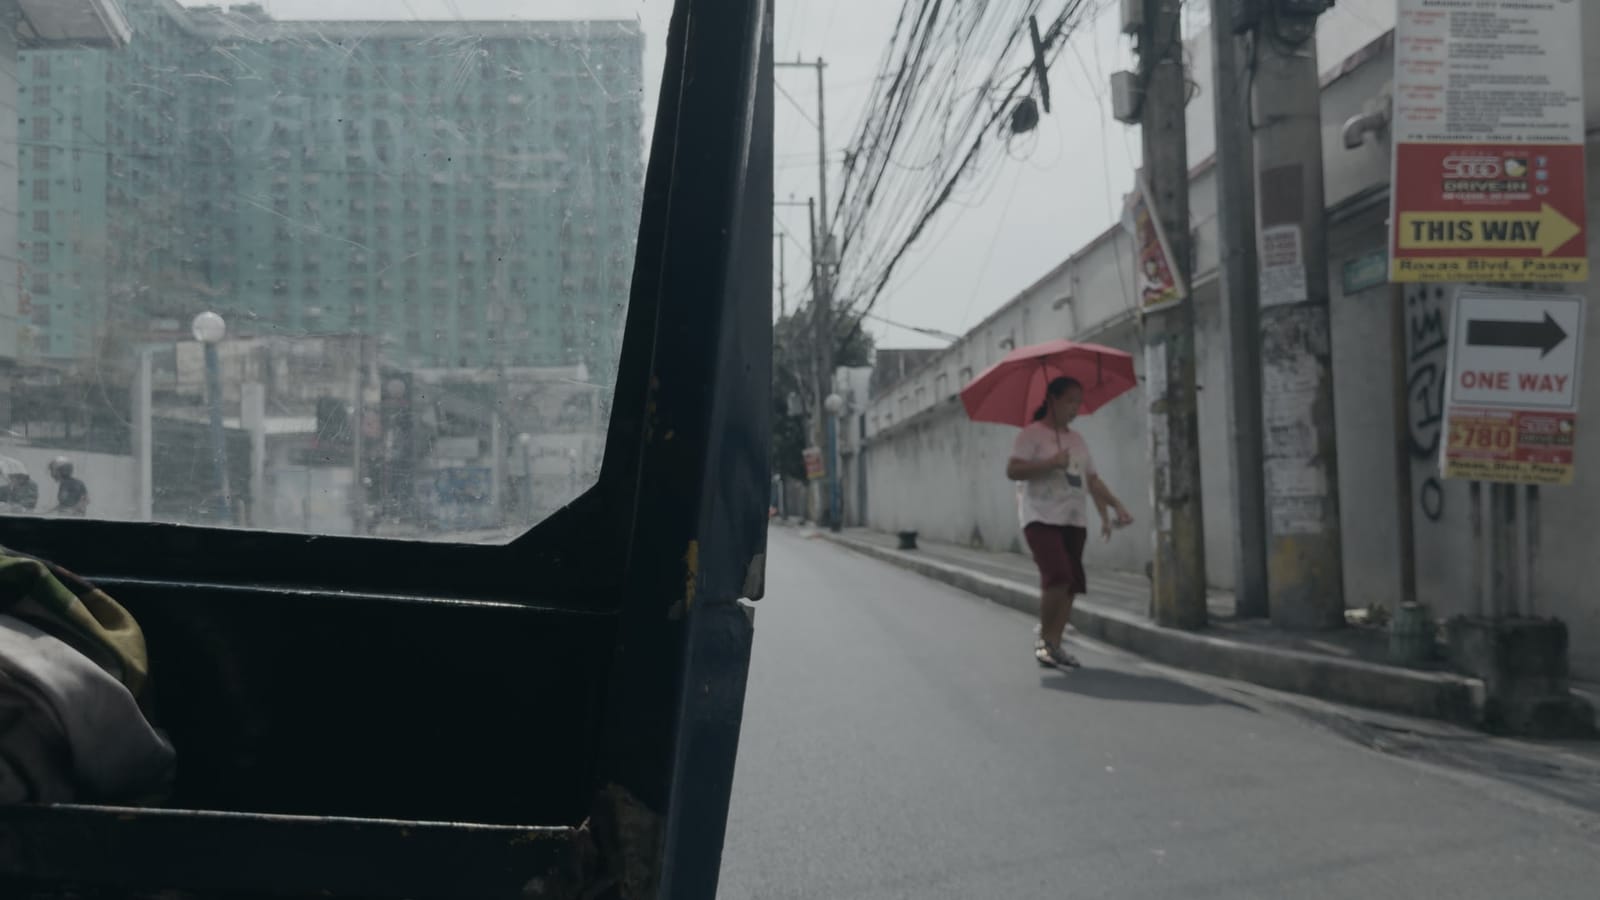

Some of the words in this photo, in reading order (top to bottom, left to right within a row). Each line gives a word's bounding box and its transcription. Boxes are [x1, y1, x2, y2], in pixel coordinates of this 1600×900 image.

[1443, 181, 1528, 192] DRIVE-IN
[1411, 220, 1473, 241] THIS
[1480, 220, 1540, 241] WAY
[1522, 259, 1581, 273] Pasay
[1460, 370, 1510, 390] ONE
[1517, 373, 1569, 392] WAY
